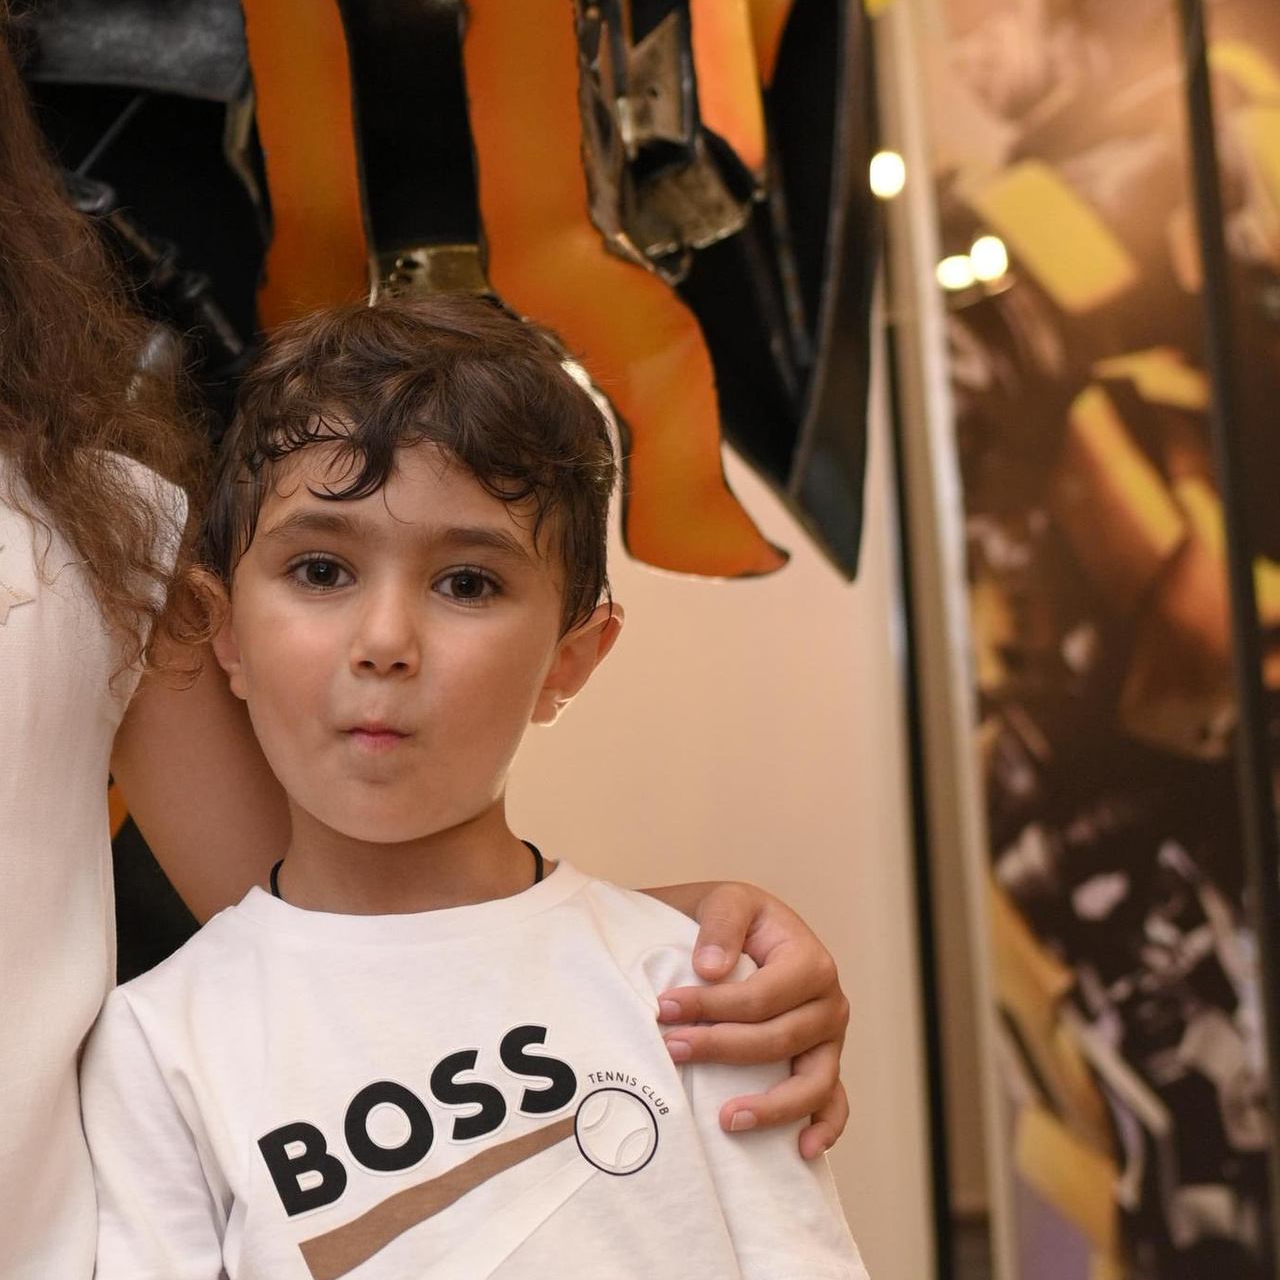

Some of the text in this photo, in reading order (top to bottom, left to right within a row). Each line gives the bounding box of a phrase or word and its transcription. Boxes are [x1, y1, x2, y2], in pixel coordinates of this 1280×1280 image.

[257, 1024, 578, 1218] BOSS
[587, 1071, 670, 1116] TENNIS CLUB
